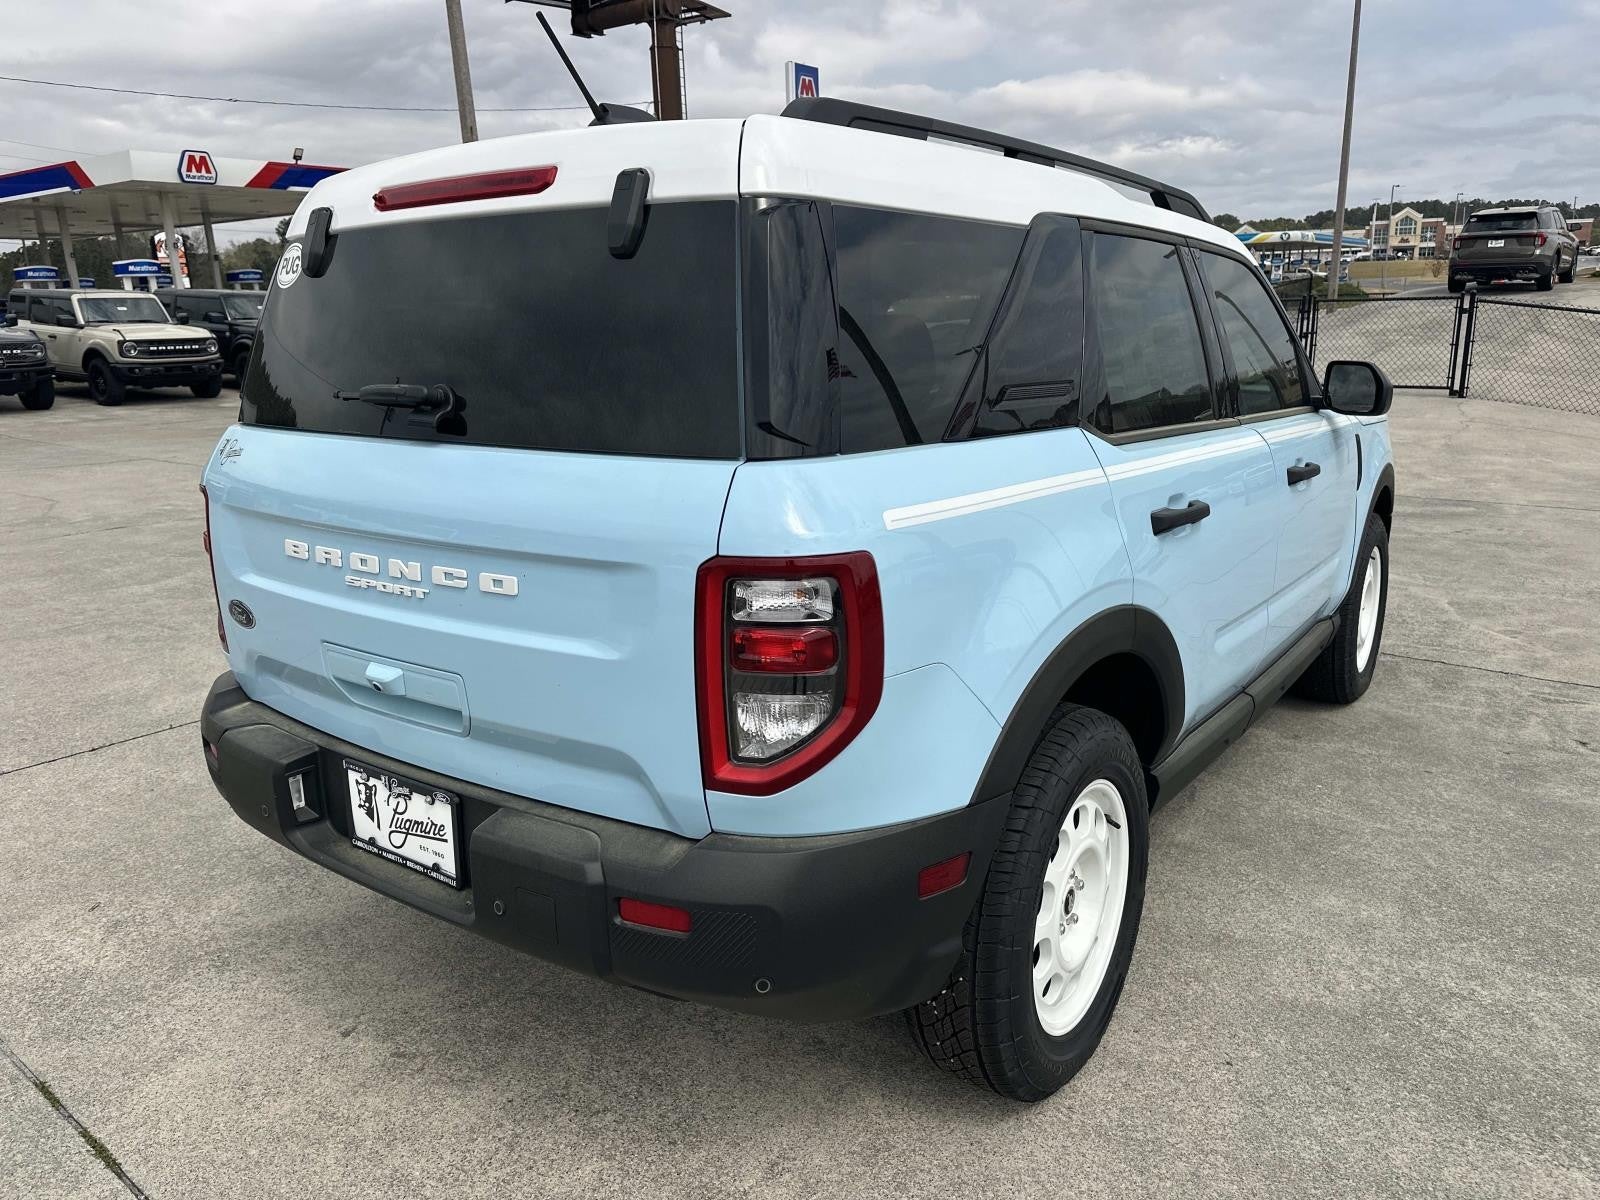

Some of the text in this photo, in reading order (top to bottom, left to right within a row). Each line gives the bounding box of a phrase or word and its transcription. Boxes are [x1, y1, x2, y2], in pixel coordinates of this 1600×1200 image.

[186, 154, 212, 175] M
[185, 173, 215, 181] Marathon
[128, 264, 159, 272] Marathon
[280, 255, 301, 276] PUG
[284, 538, 519, 596] BRONCO
[344, 575, 430, 599] SPORT
[387, 792, 449, 850] Pugmire
[352, 838, 457, 888] CARROLLTON MARIETTA BREMEN CARTERSVILLE
